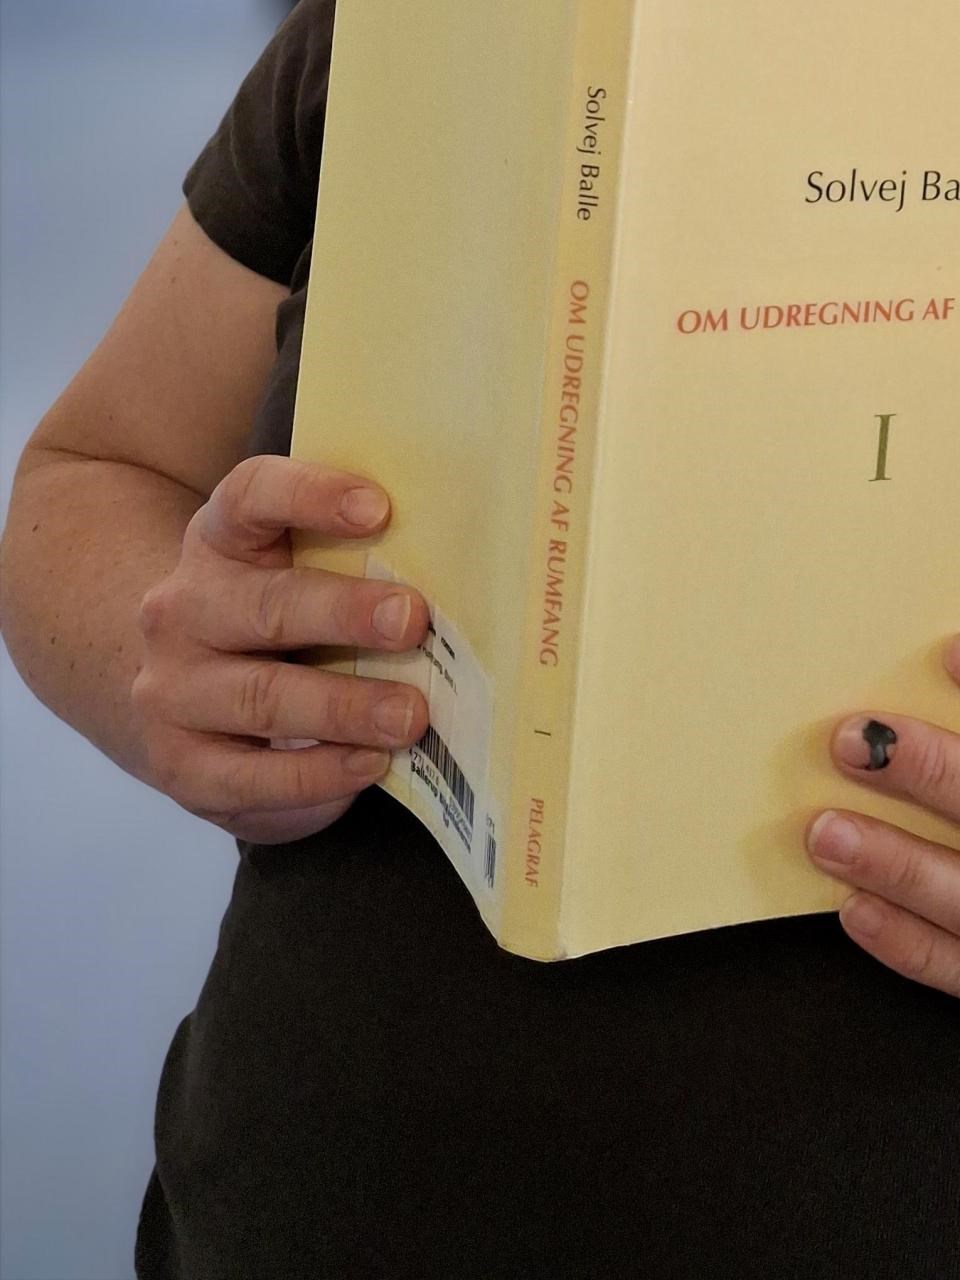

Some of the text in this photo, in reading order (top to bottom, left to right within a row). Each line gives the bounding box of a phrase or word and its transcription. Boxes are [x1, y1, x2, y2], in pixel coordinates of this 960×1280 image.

[576, 86, 606, 222] Solvej Balle
[804, 167, 908, 213] Solvej
[676, 308, 729, 335] OM
[740, 298, 915, 331] UDREGNING
[922, 297, 956, 321] AF
[540, 280, 590, 668] OM UDREGNING AF RUMFANG
[867, 413, 897, 483] I
[525, 798, 545, 888] PELAGRAF
